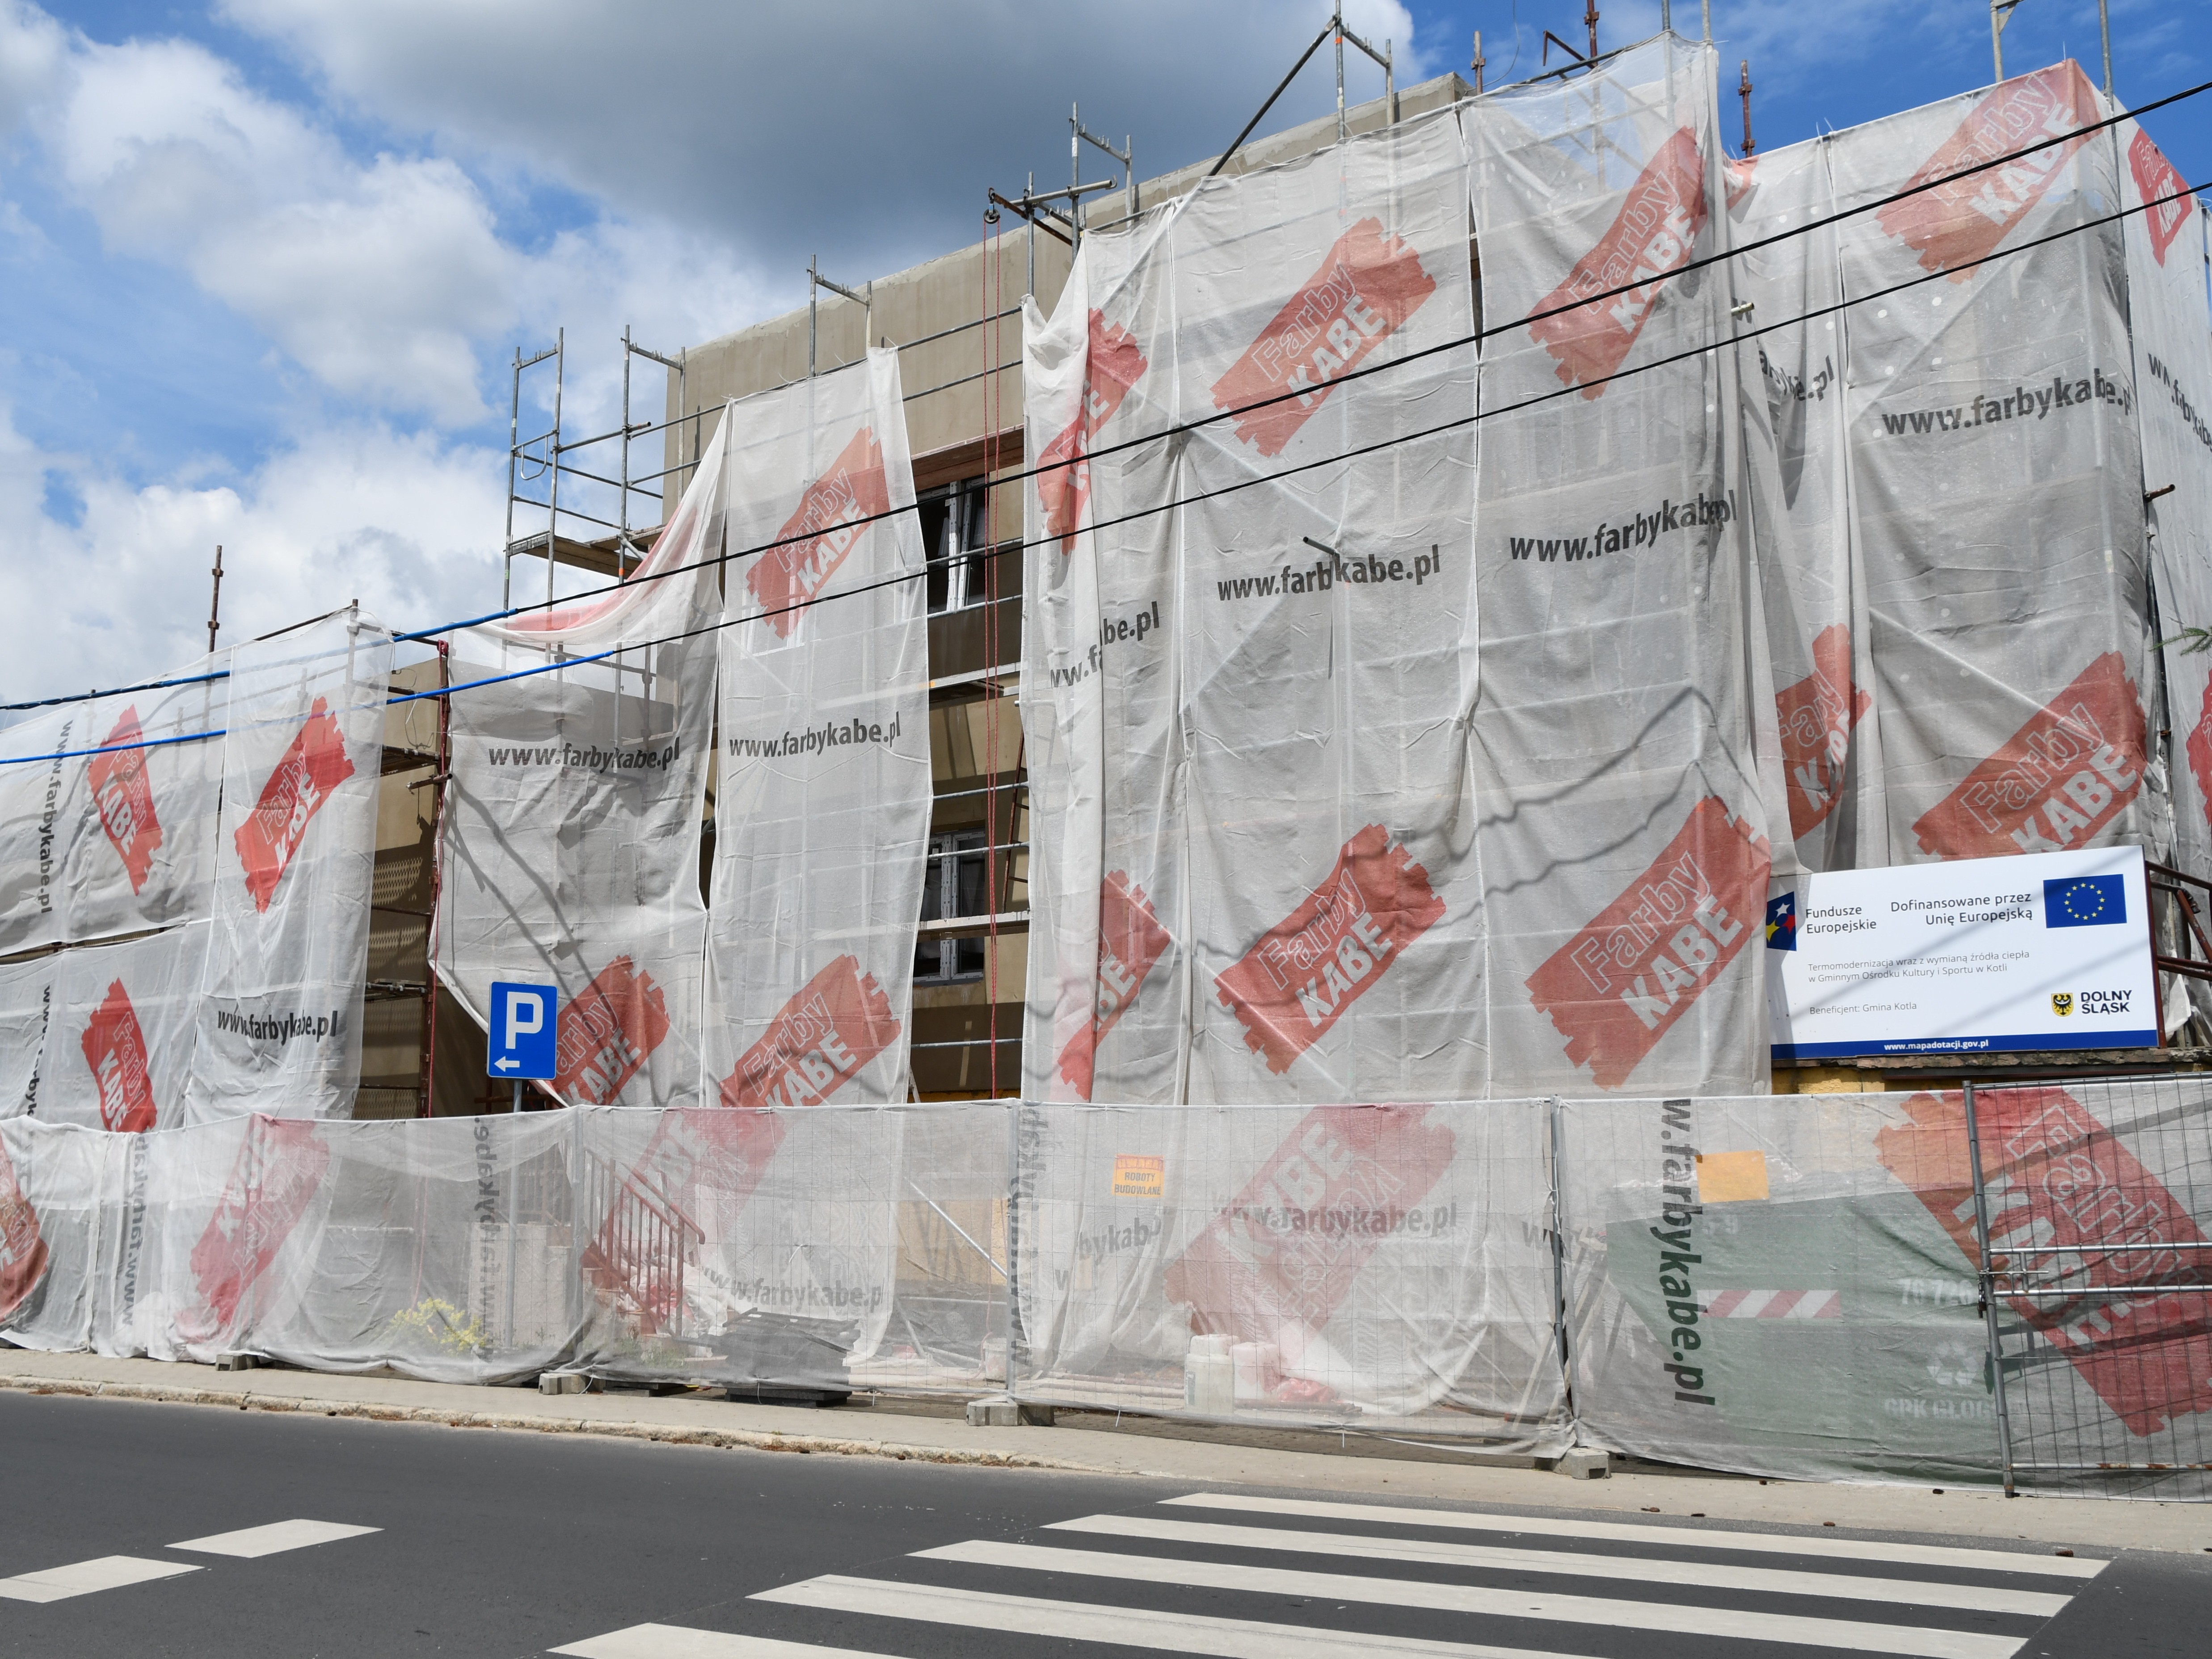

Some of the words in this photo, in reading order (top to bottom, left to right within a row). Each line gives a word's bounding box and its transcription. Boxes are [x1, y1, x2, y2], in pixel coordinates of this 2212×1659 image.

[1967, 102, 2081, 226] KABE
[1568, 170, 1681, 315] Farby
[1609, 205, 1695, 335] KABE
[1252, 258, 1356, 382] Farby
[1287, 294, 1386, 408] KABE
[774, 467, 854, 572] Farby
[797, 497, 869, 596] KABE
[1218, 544, 1441, 601] www.farbkabe.pl
[489, 737, 679, 774] www.farbykabe.pl
[729, 712, 901, 758] www.farbykabe.pl
[1960, 702, 2105, 834] Farby
[2010, 743, 2139, 853] KABE
[1257, 868, 1366, 991] Farby
[1570, 850, 1711, 994] Farby
[1805, 905, 1862, 919] Fundusze
[1806, 918, 1877, 934] Europejskie
[1891, 897, 1990, 912] Dofinansowane
[1995, 893, 2032, 906] przez
[1925, 913, 1955, 926] Unię
[1959, 907, 2033, 923] Europejską
[1295, 912, 1393, 1028] KABE
[1620, 894, 1744, 1031] KABE
[1808, 959, 1894, 971] Termomodernizacja
[1896, 958, 1917, 966] wraz
[1926, 954, 1968, 966] wymianą
[1970, 952, 1999, 961] źródła
[2001, 950, 2030, 961] ciepła
[1818, 973, 1860, 983] Gminnym
[1862, 969, 1900, 980] Ośrodku
[1902, 968, 1935, 978] Kultury
[1942, 966, 1973, 976] Sportu
[1986, 964, 2008, 972] Kotli
[506, 991, 544, 1050] P
[1810, 1005, 1860, 1015] Beneficjent:
[1862, 1003, 1892, 1012] Gmina
[1894, 1002, 1917, 1011] Kotla
[2081, 990, 2132, 1002] DOLNY
[2081, 1001, 2131, 1015] ŚLĄSK
[557, 992, 619, 1075] arby
[743, 992, 834, 1097] Farby
[1884, 1039, 1989, 1051] www.mapadotacji.gov.pl
[1114, 1184, 1162, 1196] BUDOWLANE
[1124, 1171, 1156, 1182] ROBOTY
